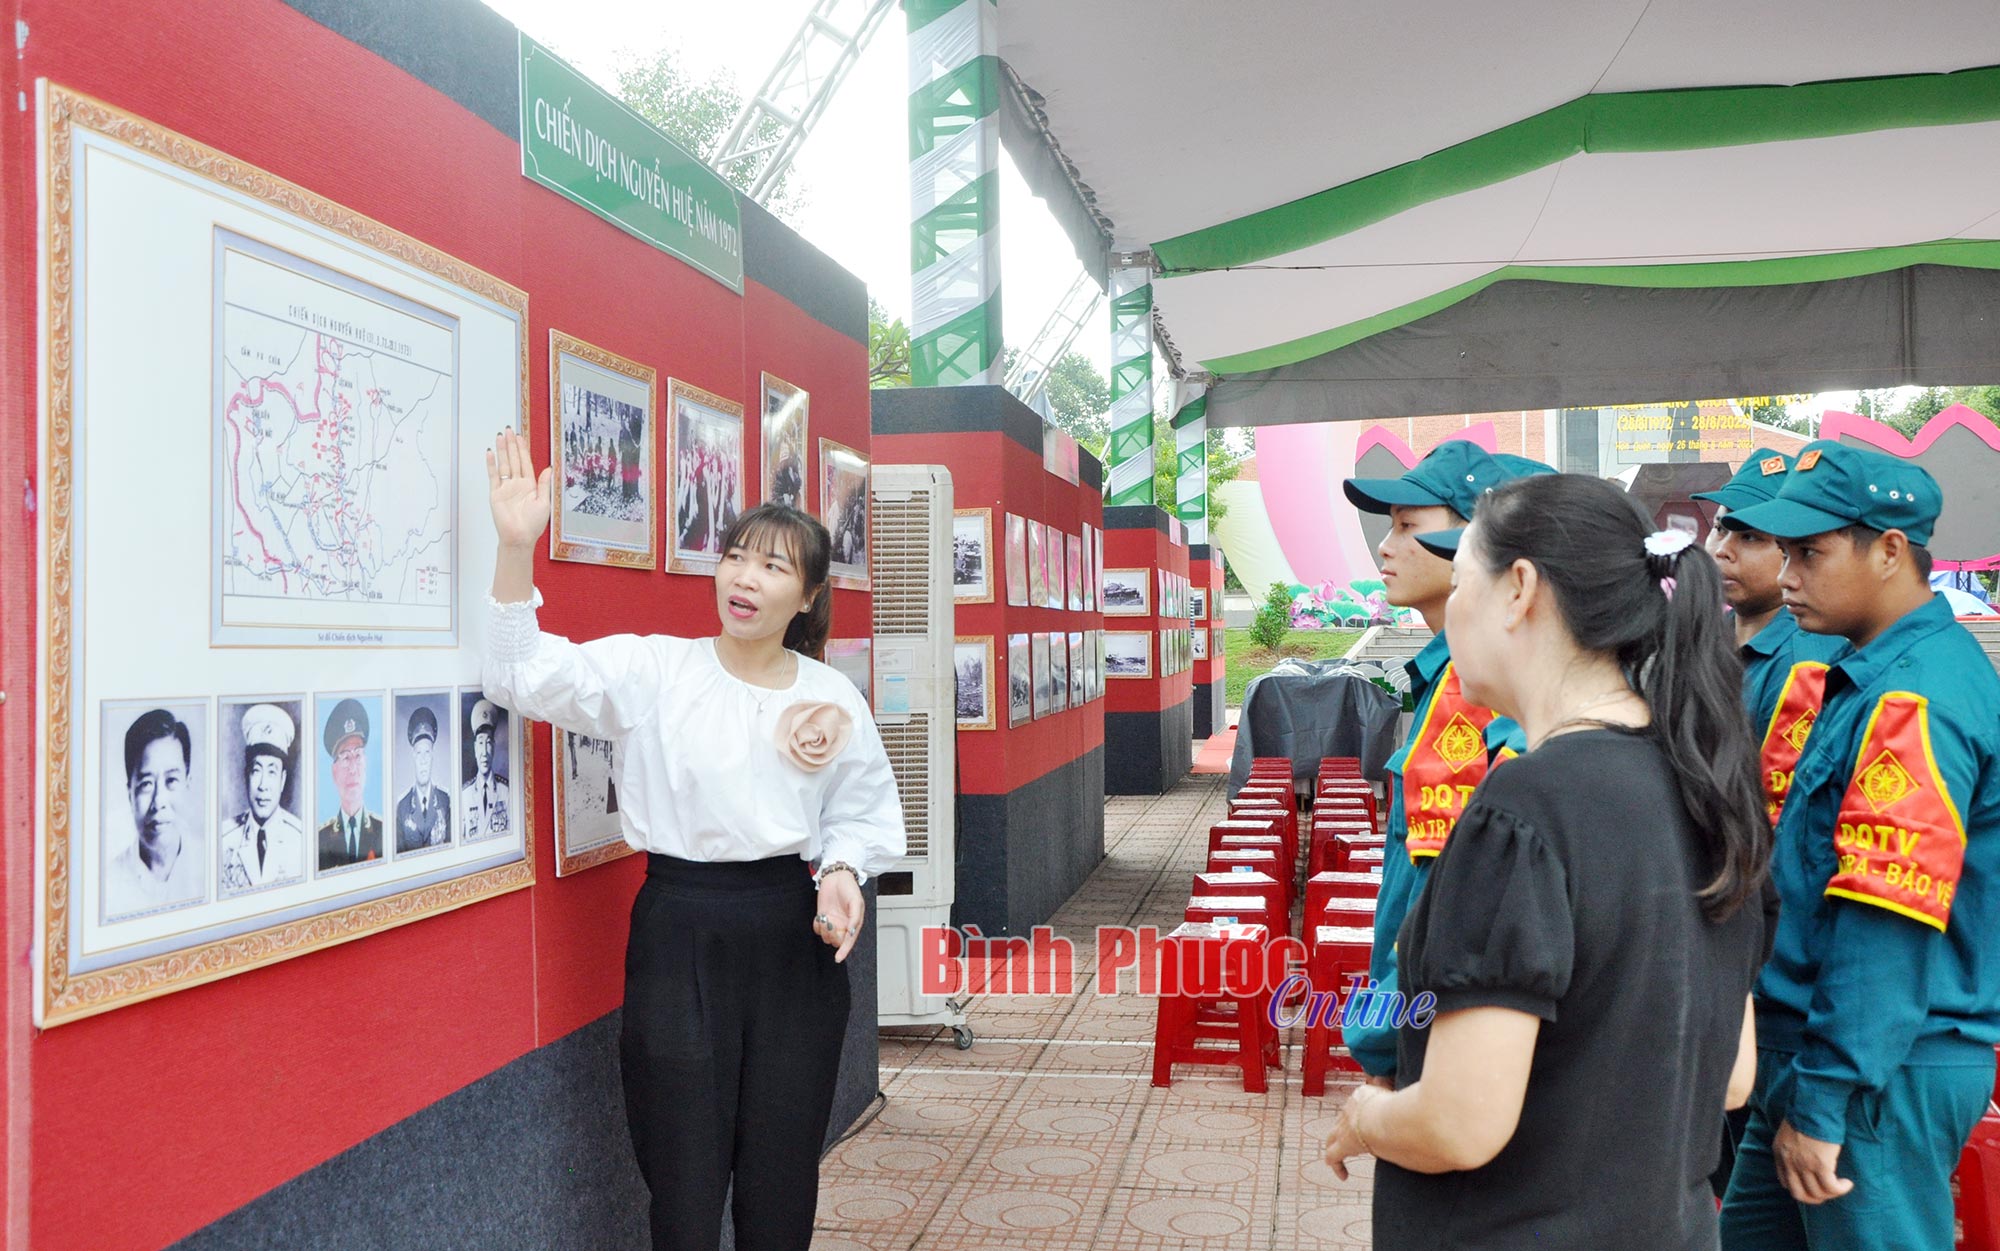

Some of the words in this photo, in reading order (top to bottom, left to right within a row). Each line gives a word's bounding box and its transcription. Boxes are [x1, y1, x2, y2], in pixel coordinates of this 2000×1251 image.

[535, 96, 582, 161] CHIẾN
[585, 128, 617, 183] DỊCH
[620, 152, 670, 215] NGUYỄN
[672, 185, 694, 237] HUỆ
[695, 199, 717, 245] NĂM
[718, 219, 737, 257] 1972
[1421, 784, 1476, 811] DQT
[1838, 823, 1920, 857] DQTV
[1885, 861, 1932, 896] BẢO
